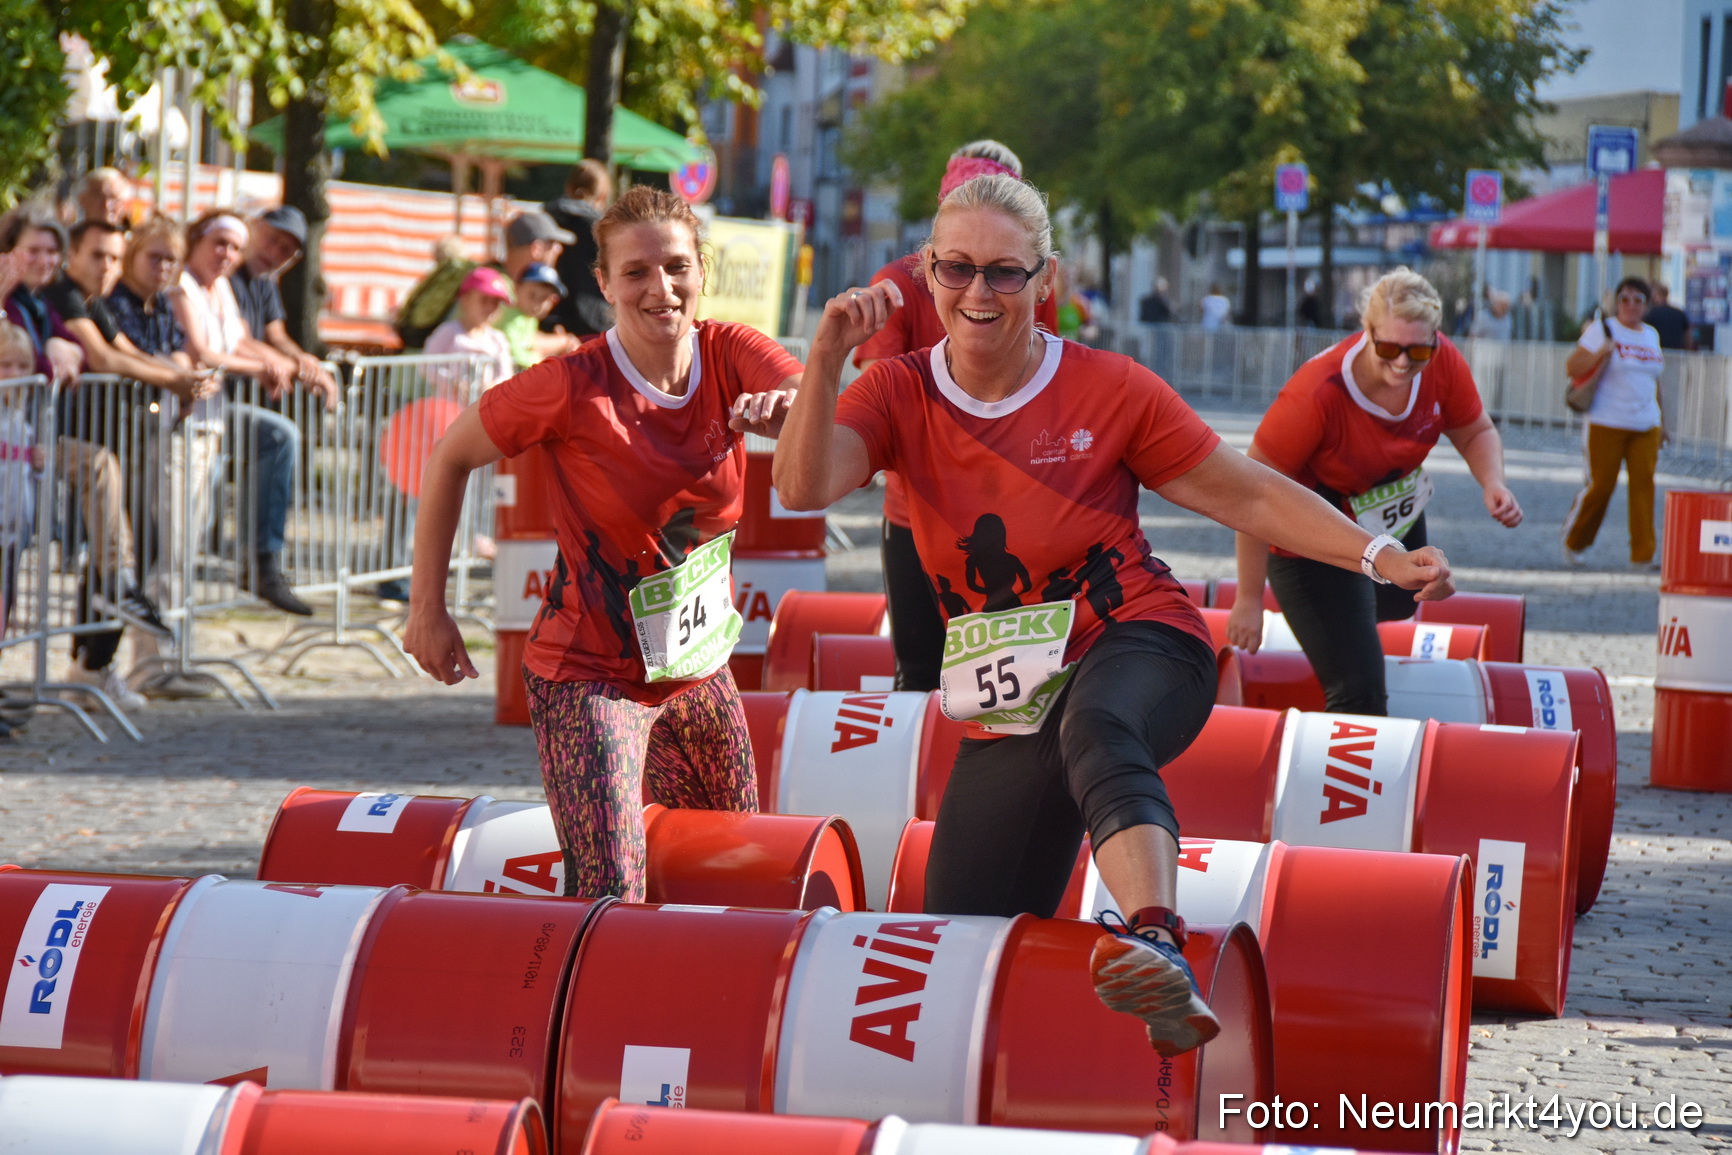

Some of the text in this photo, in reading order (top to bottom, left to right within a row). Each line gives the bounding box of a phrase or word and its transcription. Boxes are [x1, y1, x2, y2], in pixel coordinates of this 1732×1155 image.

[1030, 455, 1066, 465] nürnberg
[1357, 467, 1421, 508] BOC
[1382, 496, 1415, 530] 56
[640, 540, 724, 611] BOCK
[679, 594, 707, 646] 54
[944, 609, 1058, 663] BOCK
[1048, 648, 1059, 656] E6
[975, 655, 1021, 709] 55
[509, 1025, 527, 1058] 323
